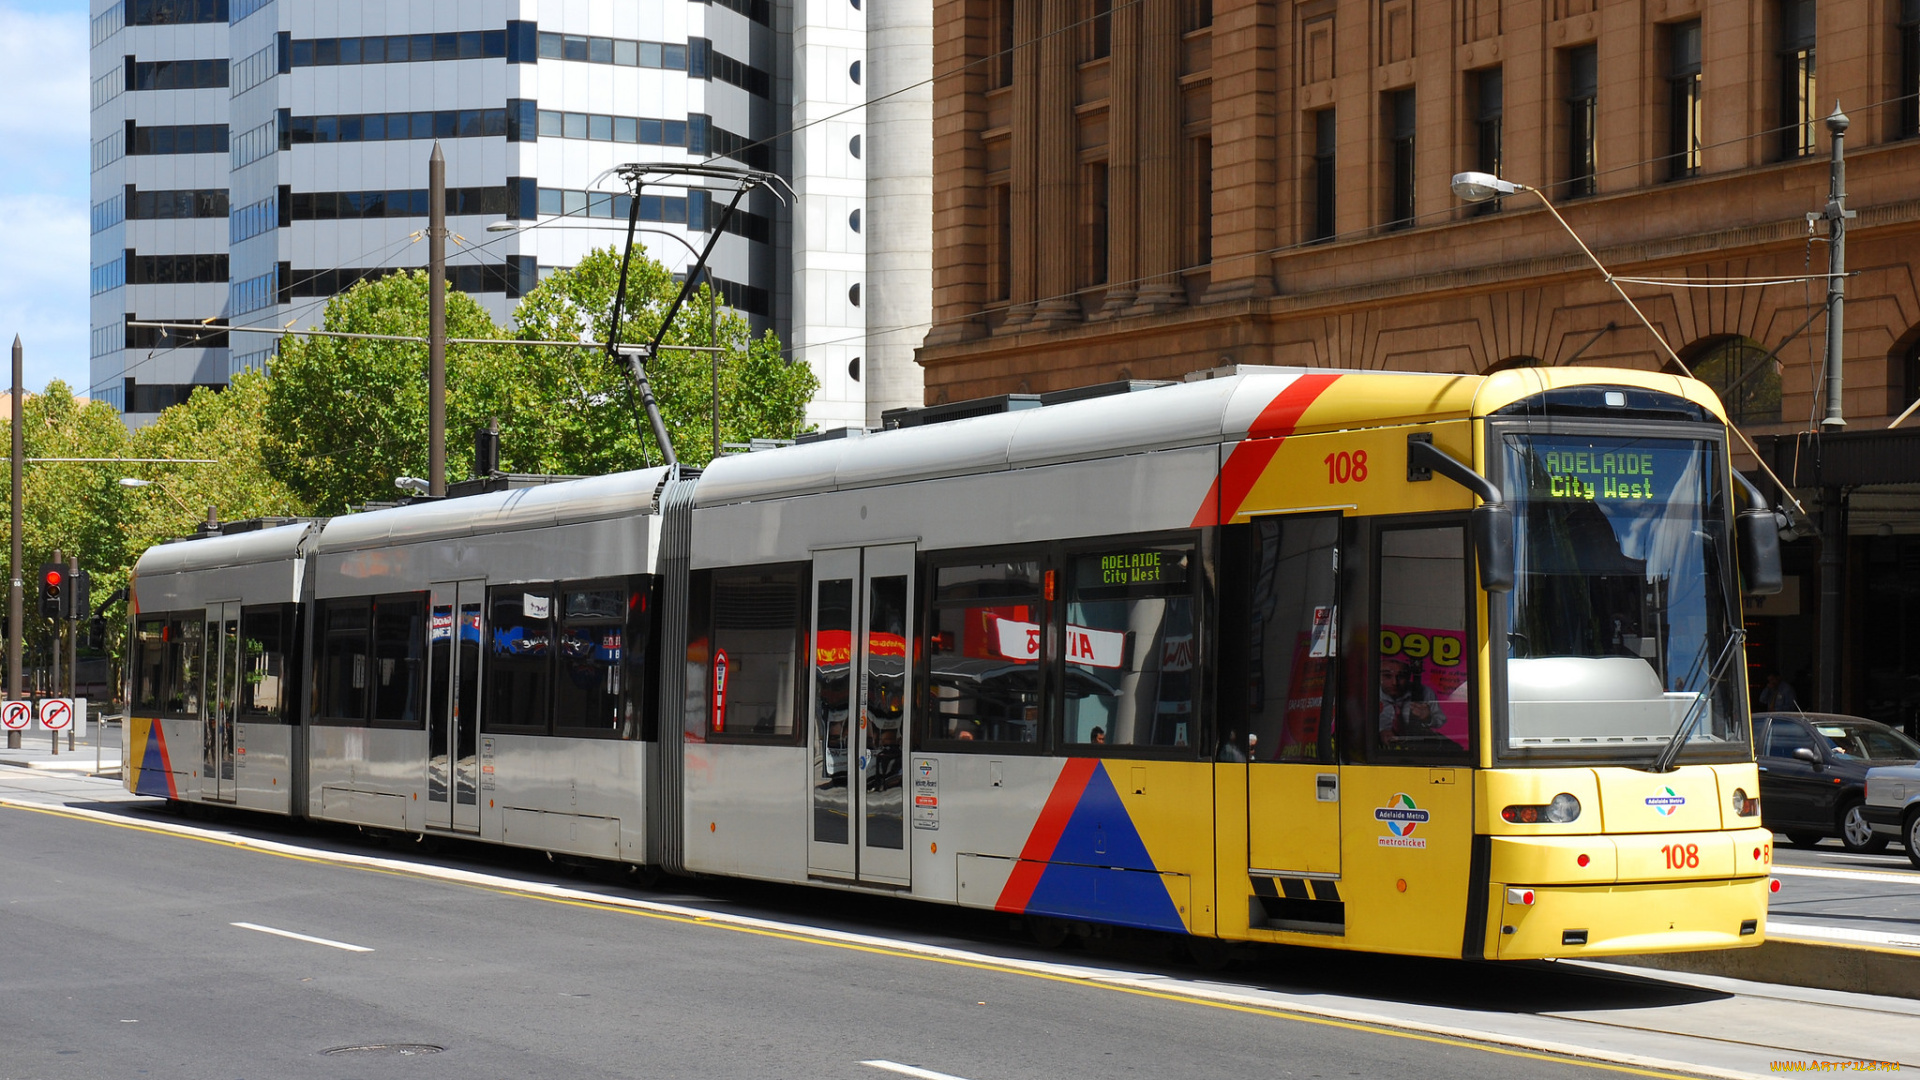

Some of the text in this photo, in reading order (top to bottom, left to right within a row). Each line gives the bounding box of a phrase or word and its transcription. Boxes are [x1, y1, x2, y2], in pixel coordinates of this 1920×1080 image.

[1323, 449, 1368, 484] 108
[1546, 451, 1654, 475] ADELAIDE
[1550, 475, 1654, 500] City West
[1101, 552, 1162, 570] ADELAIDE
[1103, 566, 1160, 584] City West
[1379, 811, 1425, 820] Adelaide Metro
[1379, 838, 1425, 848] metroticket
[1661, 843, 1700, 869] 108
[1763, 844, 1770, 865] B
